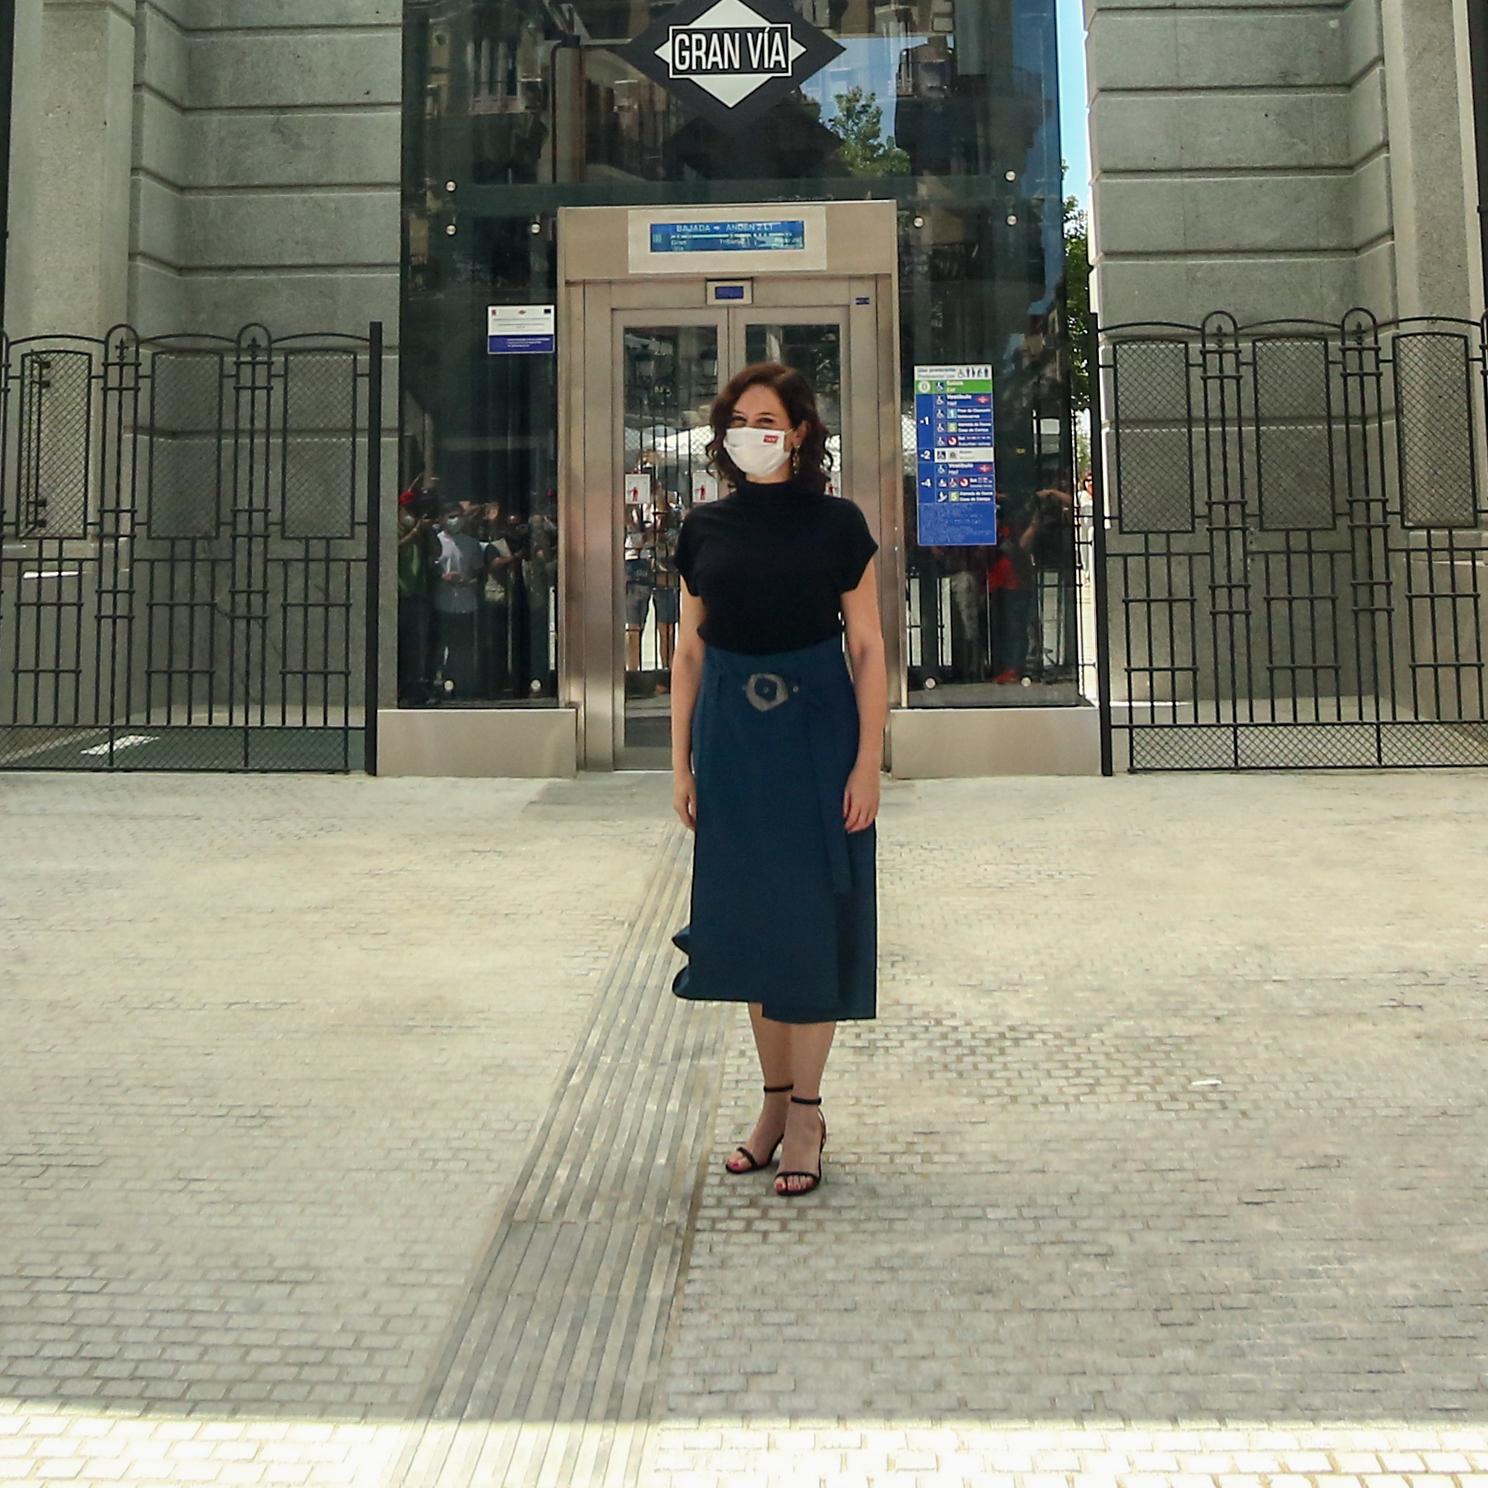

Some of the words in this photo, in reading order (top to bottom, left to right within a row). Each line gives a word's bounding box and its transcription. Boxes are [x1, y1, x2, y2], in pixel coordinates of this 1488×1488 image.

[674, 32, 741, 71] GRAN
[746, 26, 787, 69] VÍA
[676, 223, 711, 233] BAJADA
